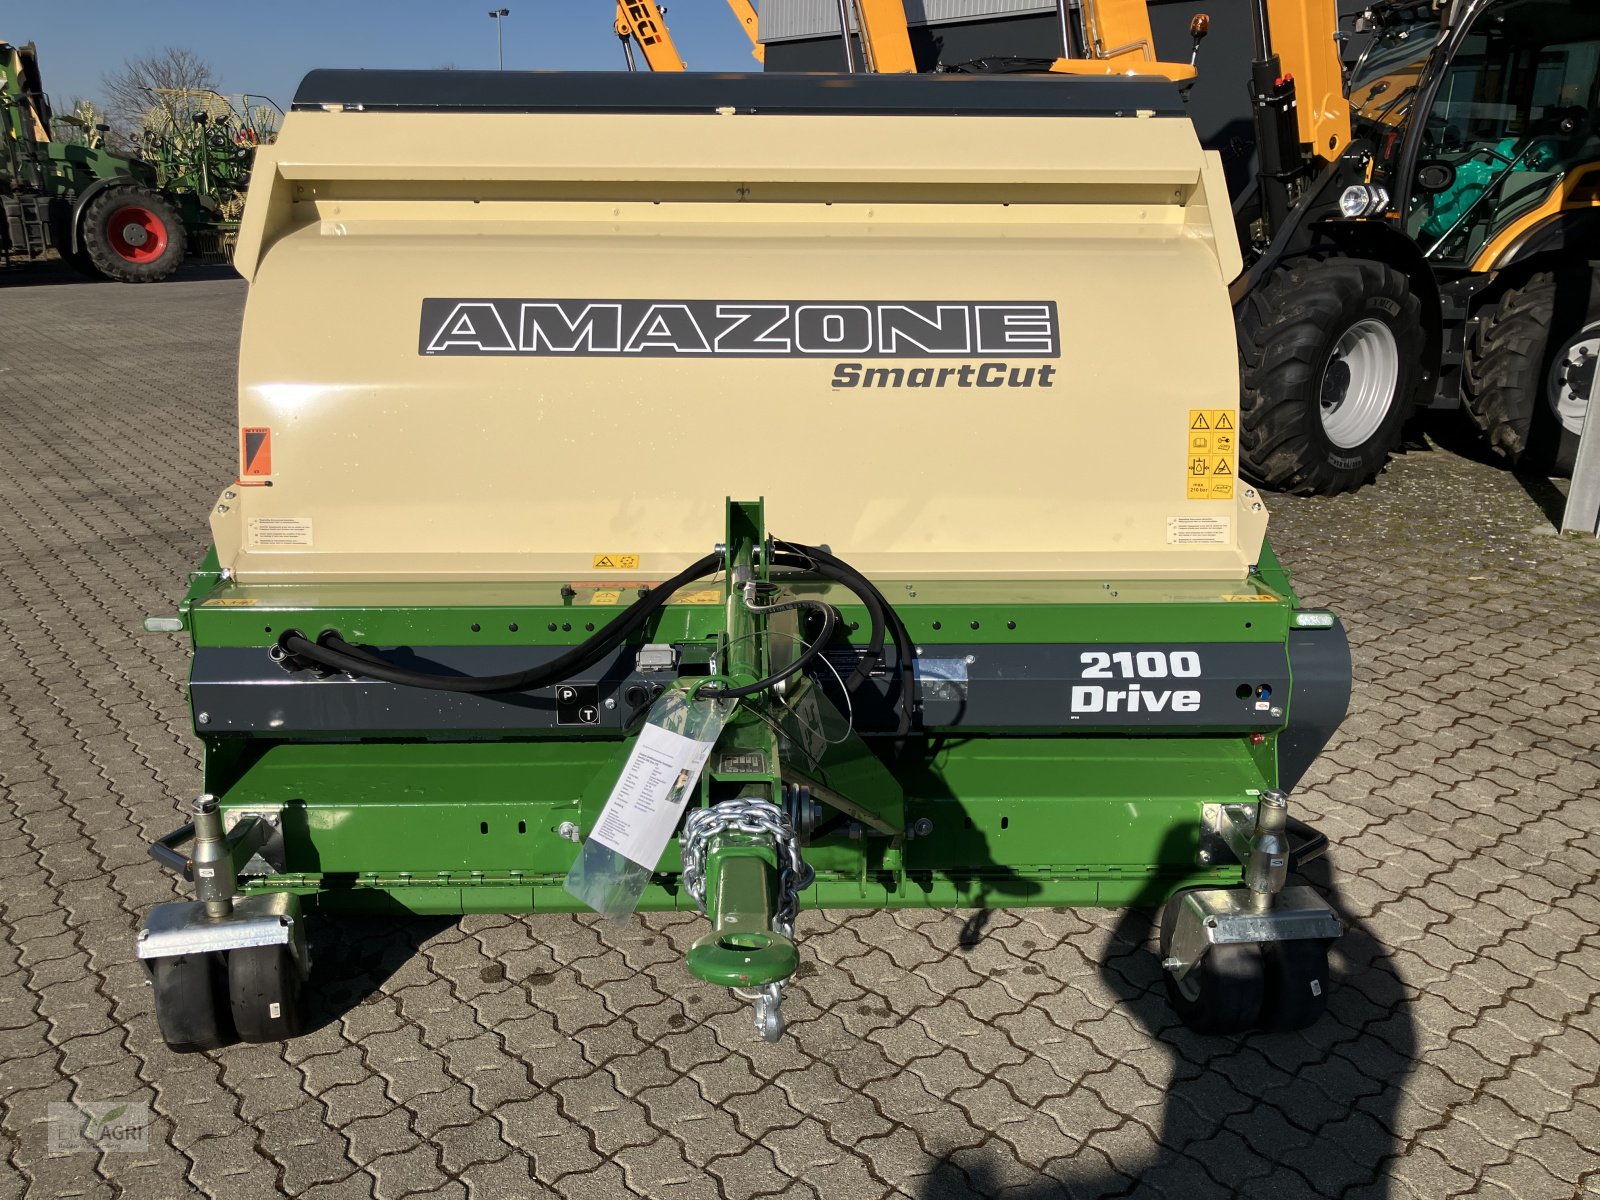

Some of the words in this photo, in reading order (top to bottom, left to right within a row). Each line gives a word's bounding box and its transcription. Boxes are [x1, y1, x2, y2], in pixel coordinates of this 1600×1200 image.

[426, 303, 1053, 353] AMAZONE
[831, 362, 1056, 388] SmartCut
[1080, 651, 1202, 679] 2100
[563, 690, 573, 700] P
[1070, 683, 1201, 713] Drive
[584, 709, 594, 720] T
